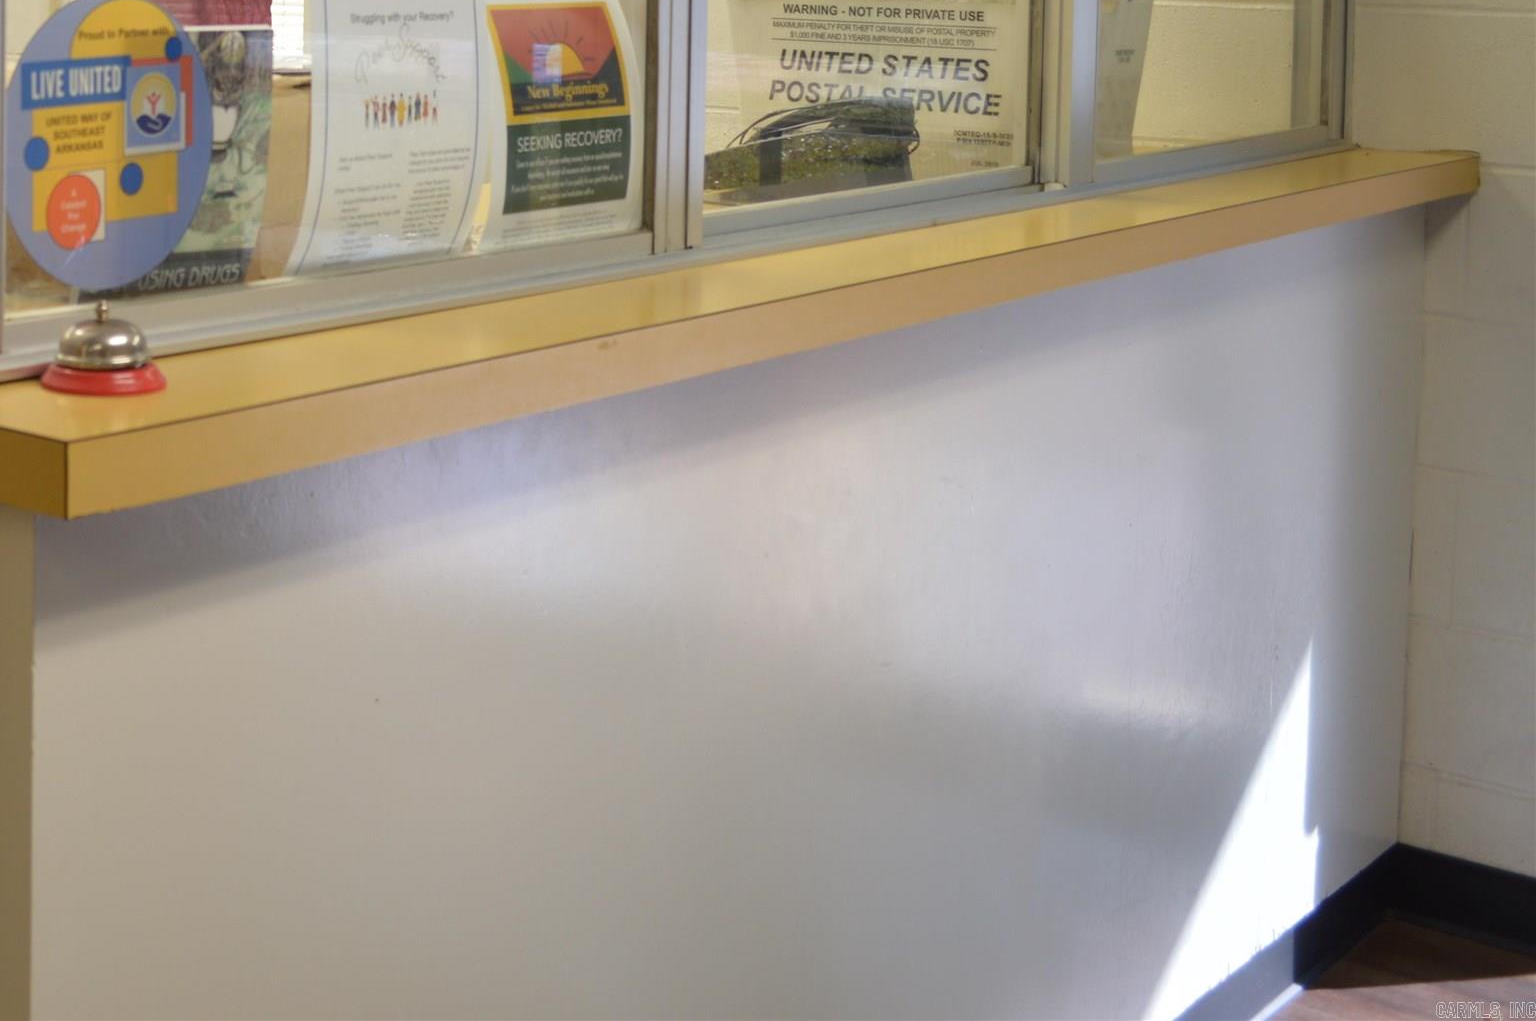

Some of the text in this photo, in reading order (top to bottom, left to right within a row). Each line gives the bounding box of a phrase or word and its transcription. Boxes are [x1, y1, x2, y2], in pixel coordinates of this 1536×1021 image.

[783, 3, 838, 16] WARNING
[848, 6, 873, 17] NOT
[876, 7, 901, 18] FOR
[904, 8, 956, 20] PRIVATE
[959, 11, 985, 22] USE
[78, 29, 105, 41] Proud
[773, 20, 804, 29] MAXIMUM
[805, 22, 835, 31] PENALTY
[836, 23, 852, 31] FOR
[852, 24, 875, 33] THEFT
[875, 25, 887, 33] OR
[915, 26, 925, 34] OF
[926, 27, 954, 36] POSTAL
[955, 28, 996, 37] PROPERTY
[780, 48, 990, 82] UNITED STATES
[31, 65, 122, 100] LIVE UNITED
[527, 81, 608, 102] New Beginnings
[882, 87, 1002, 117] SERVICE
[46, 111, 112, 128] UNITED WAY OF
[53, 125, 106, 141] SOUTHEAST
[517, 128, 623, 154] SEEKING RECOVERY?
[56, 140, 104, 154] ARKANSAS
[138, 263, 241, 291] USING DRUGS
